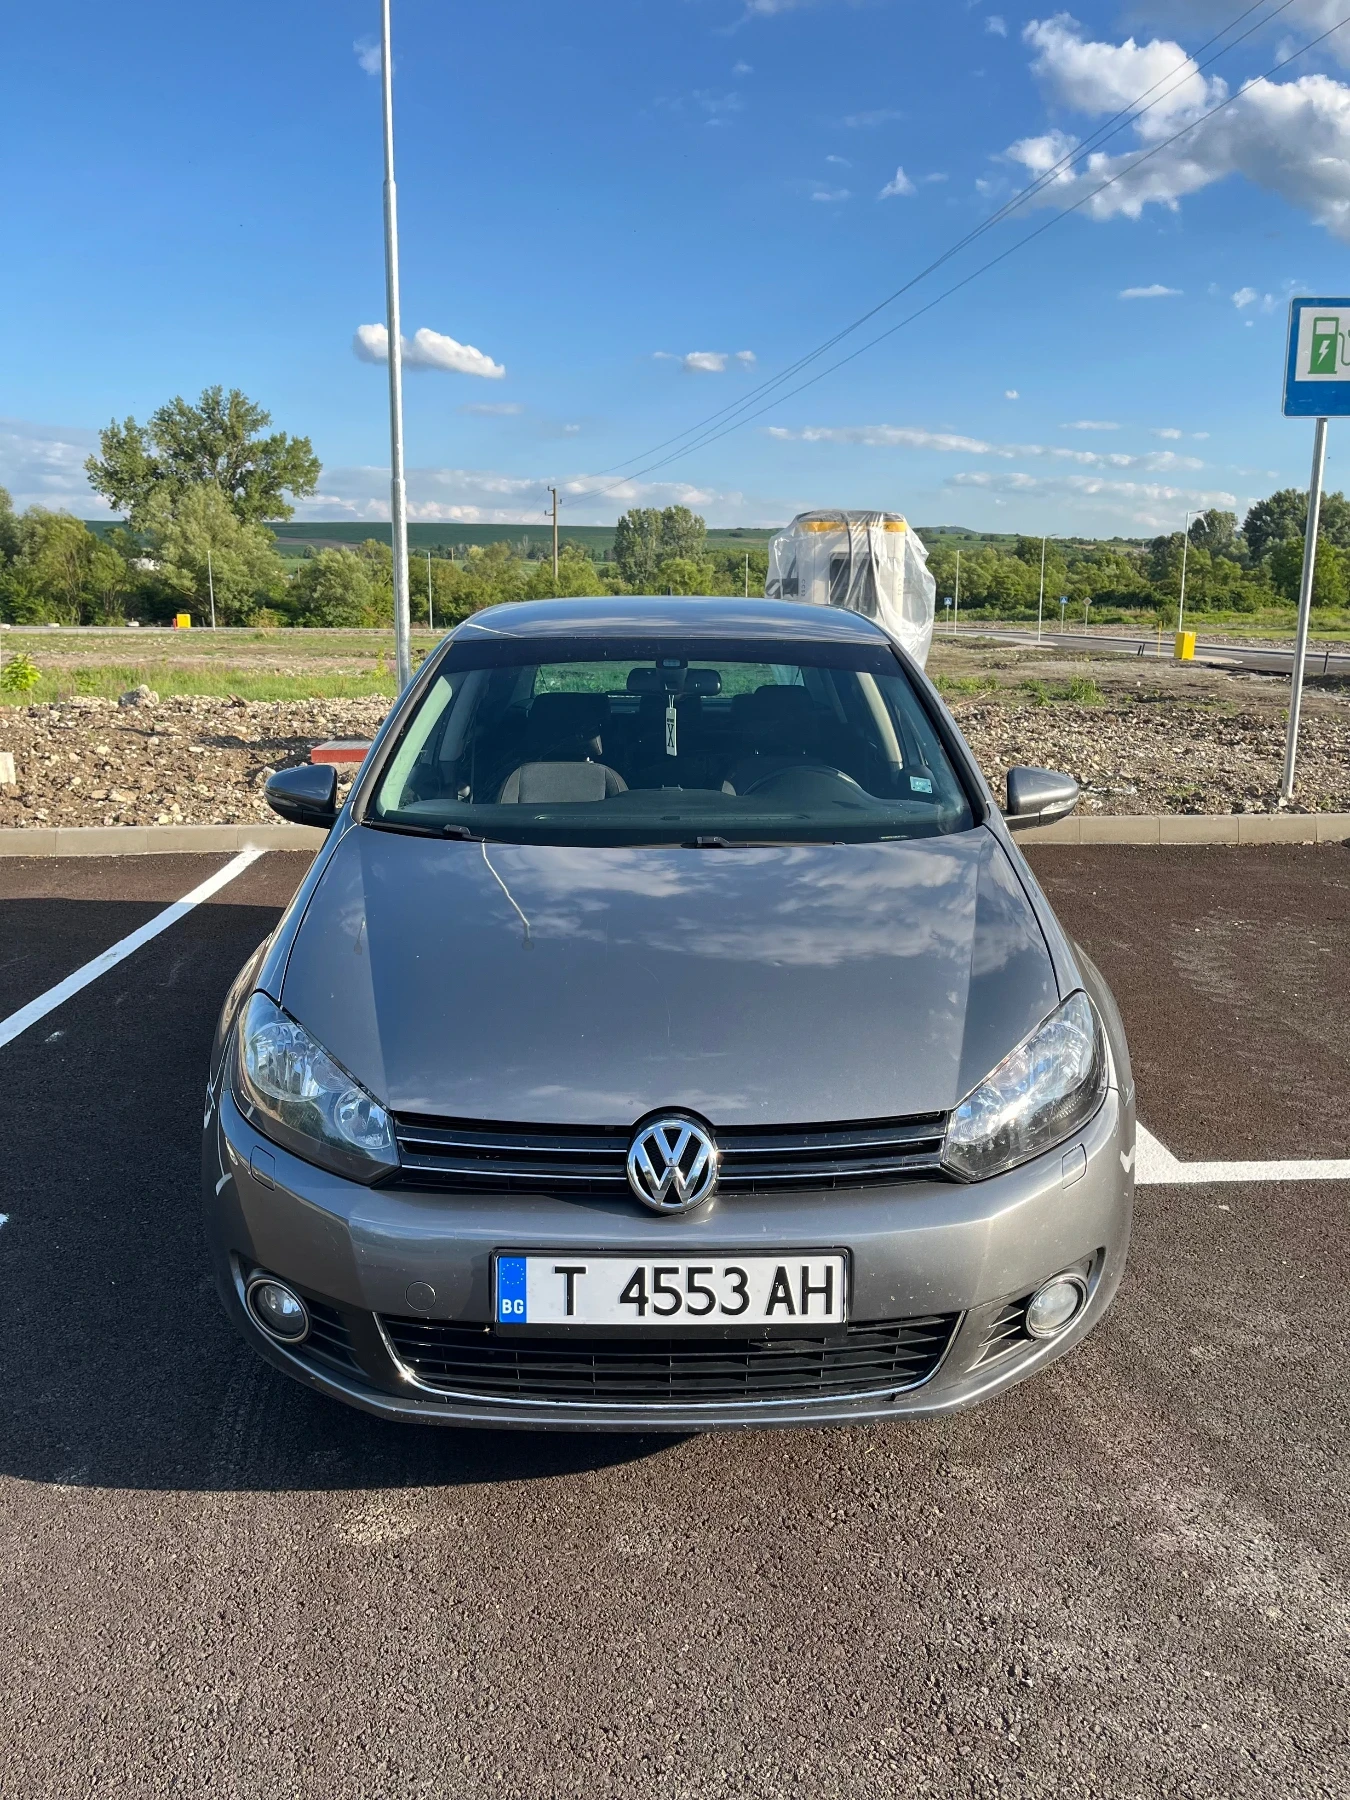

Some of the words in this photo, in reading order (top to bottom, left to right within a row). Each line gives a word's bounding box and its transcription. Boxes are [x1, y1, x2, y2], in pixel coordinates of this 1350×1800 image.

[627, 1119, 717, 1213] VW
[502, 1299, 524, 1315] BG
[554, 1266, 587, 1316] T
[619, 1266, 750, 1316] 4553
[765, 1265, 834, 1316] AH
